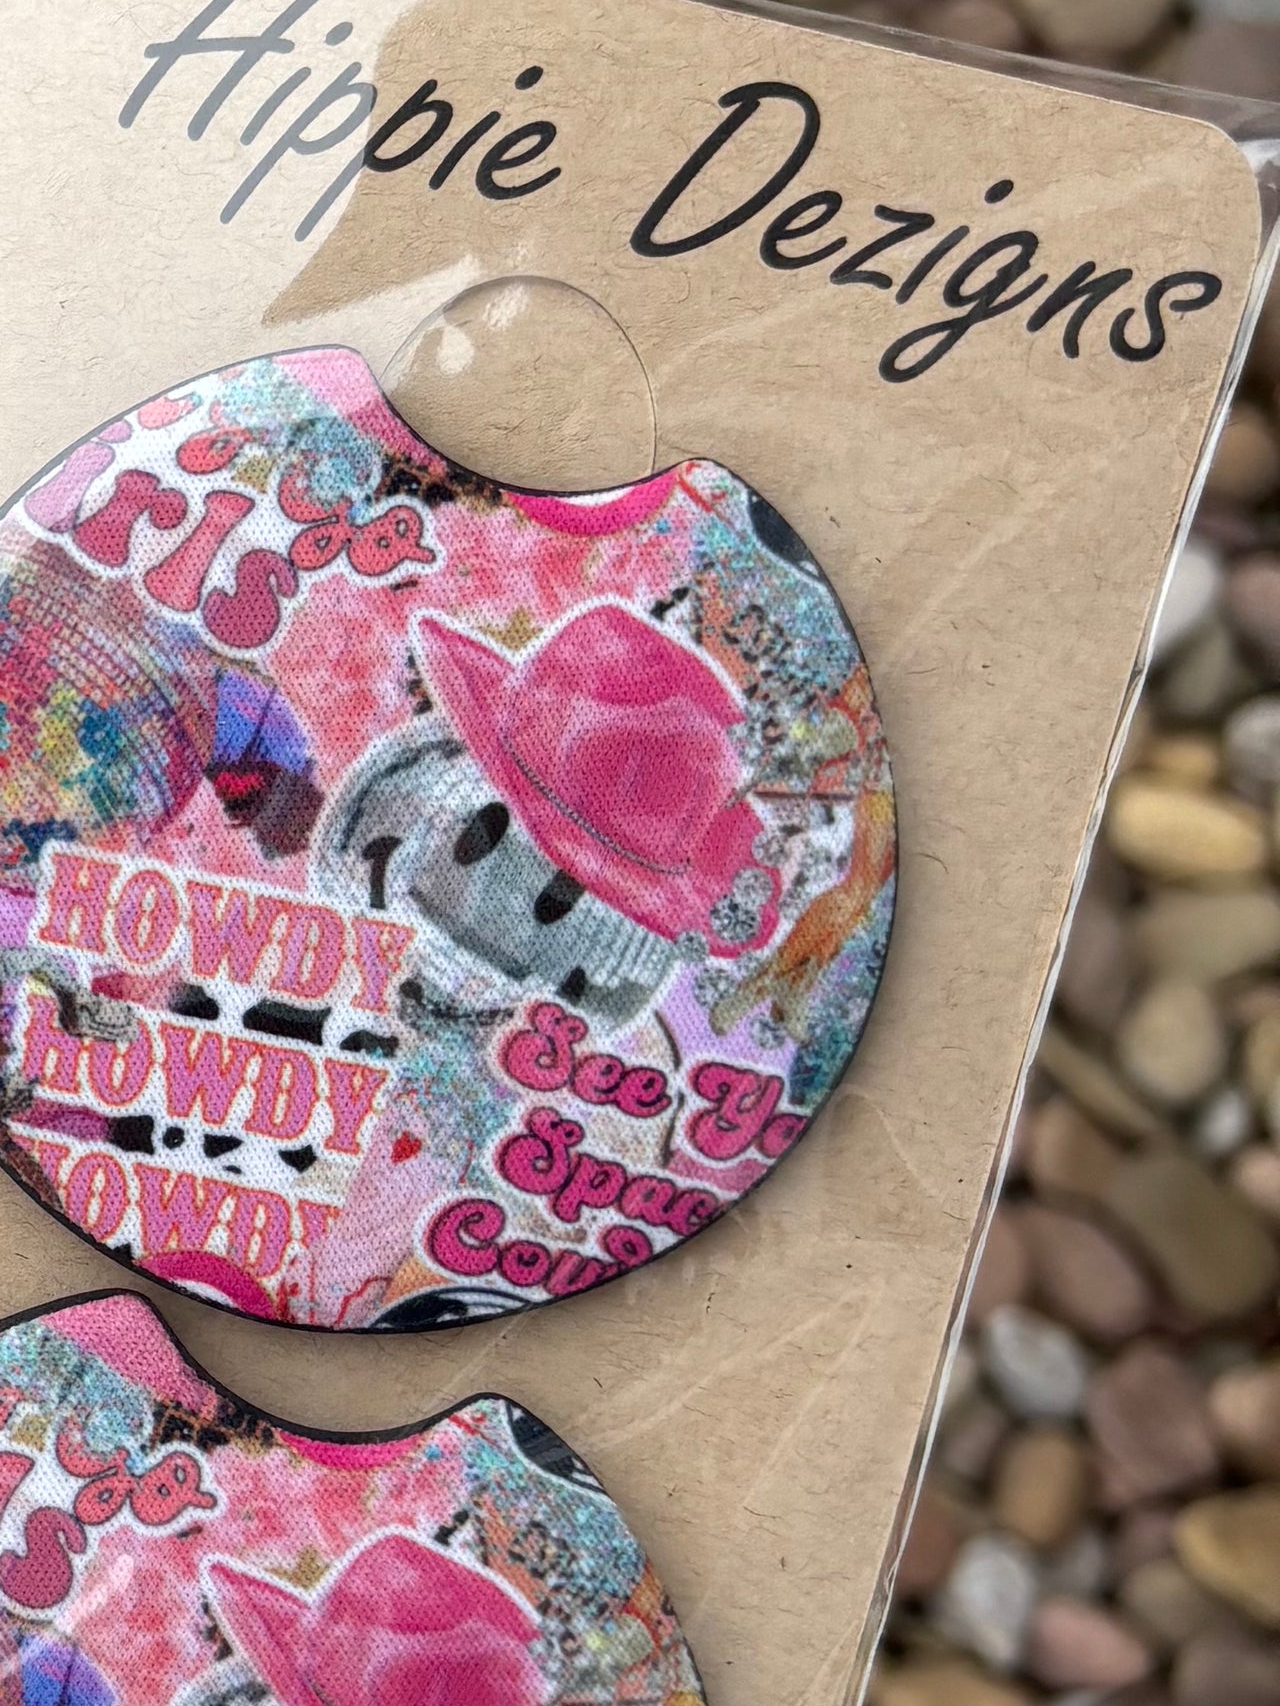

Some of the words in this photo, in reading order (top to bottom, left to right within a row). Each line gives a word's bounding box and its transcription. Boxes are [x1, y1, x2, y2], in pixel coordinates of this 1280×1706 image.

[629, 80, 1224, 383] Dezigns
[39, 852, 416, 1014] HOWDY
[22, 990, 391, 1154] HOWDY
[496, 1001, 673, 1119] See
